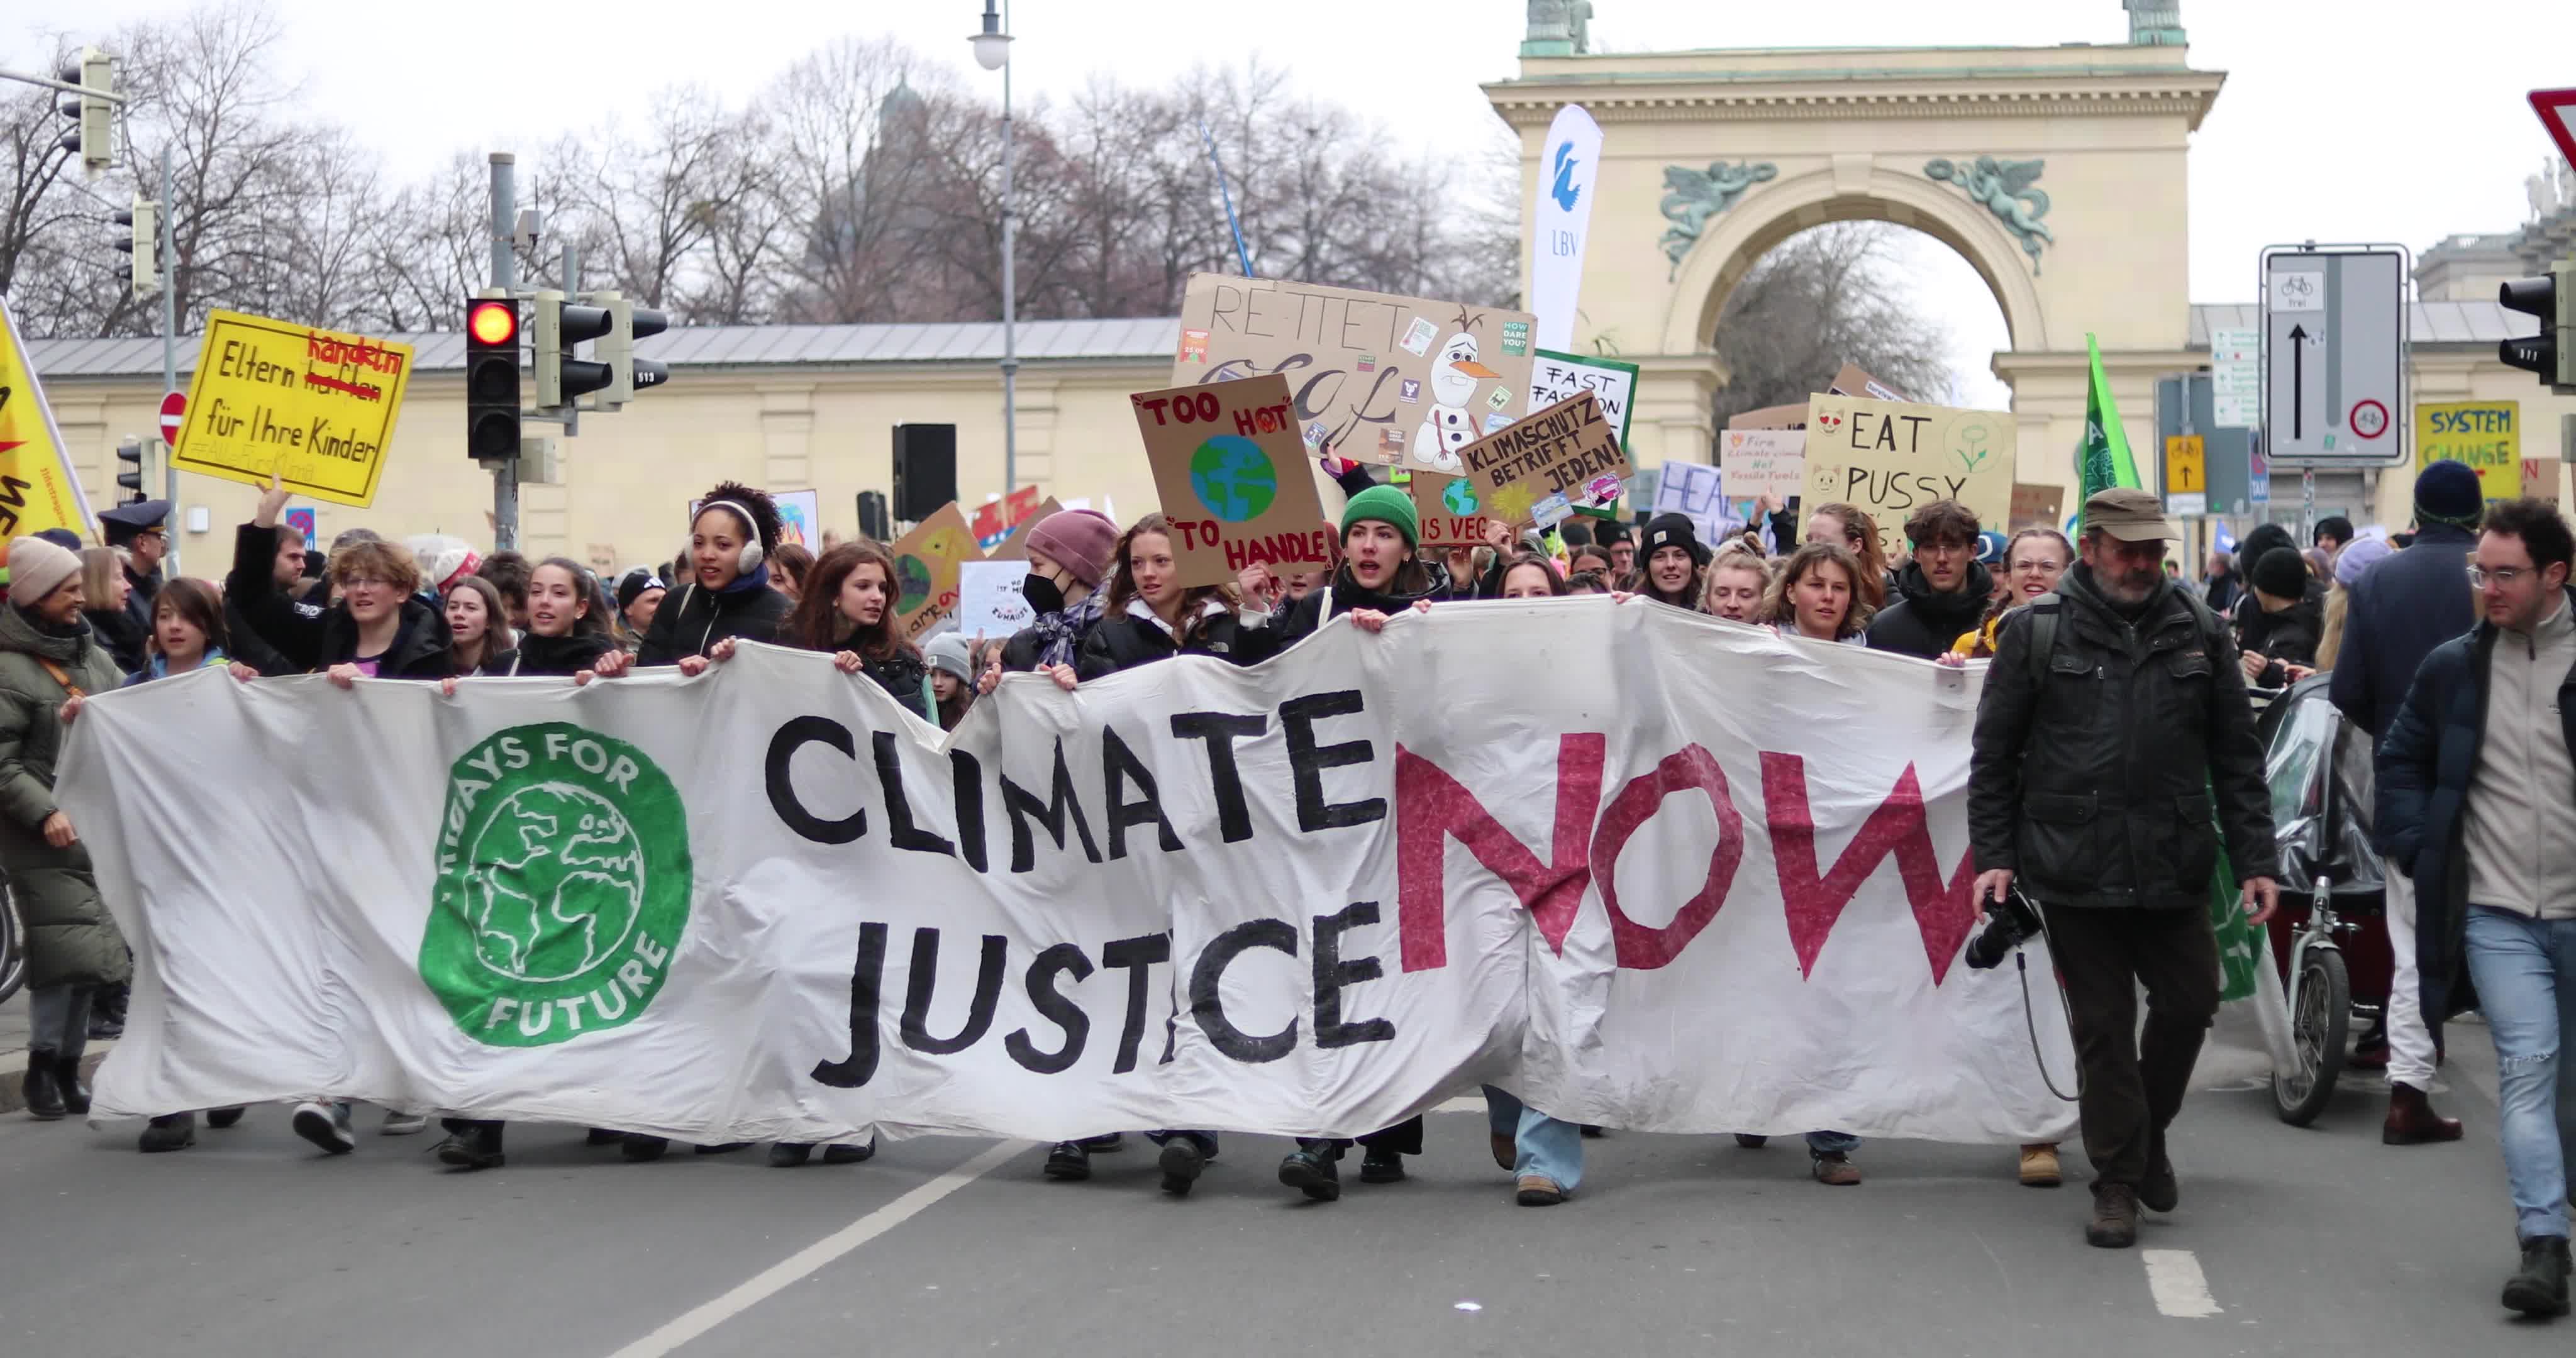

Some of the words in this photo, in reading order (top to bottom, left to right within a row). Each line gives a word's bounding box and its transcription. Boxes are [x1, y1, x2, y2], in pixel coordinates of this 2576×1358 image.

[1552, 229, 1579, 257] LBV
[1211, 285, 1409, 353] RETTET
[2289, 299, 2306, 307] frei
[1503, 331, 1526, 339] DARE
[1503, 339, 1526, 347] YOU?
[1504, 321, 1528, 330] HOW
[219, 340, 295, 388] Eltern
[307, 330, 400, 375] handeln
[1546, 367, 1617, 393] FAST
[206, 398, 244, 438] für
[250, 405, 302, 447] Ihre
[307, 416, 377, 463] Kinder
[1467, 397, 1602, 472] KLIMASCHUTZ
[1852, 412, 1932, 453] EAT
[2431, 410, 2511, 433] SYSTEM
[1490, 429, 1580, 487] BETRIFFT
[1544, 434, 1624, 494] JEDEN!
[2423, 441, 2510, 466] CHANGE
[1846, 467, 1967, 509] PUSSY
[1422, 518, 1441, 541] IS
[545, 732, 639, 795] FOR
[765, 690, 1387, 874] CLIMATE
[1396, 732, 1976, 989] NOW
[484, 930, 669, 1037] FUTURE
